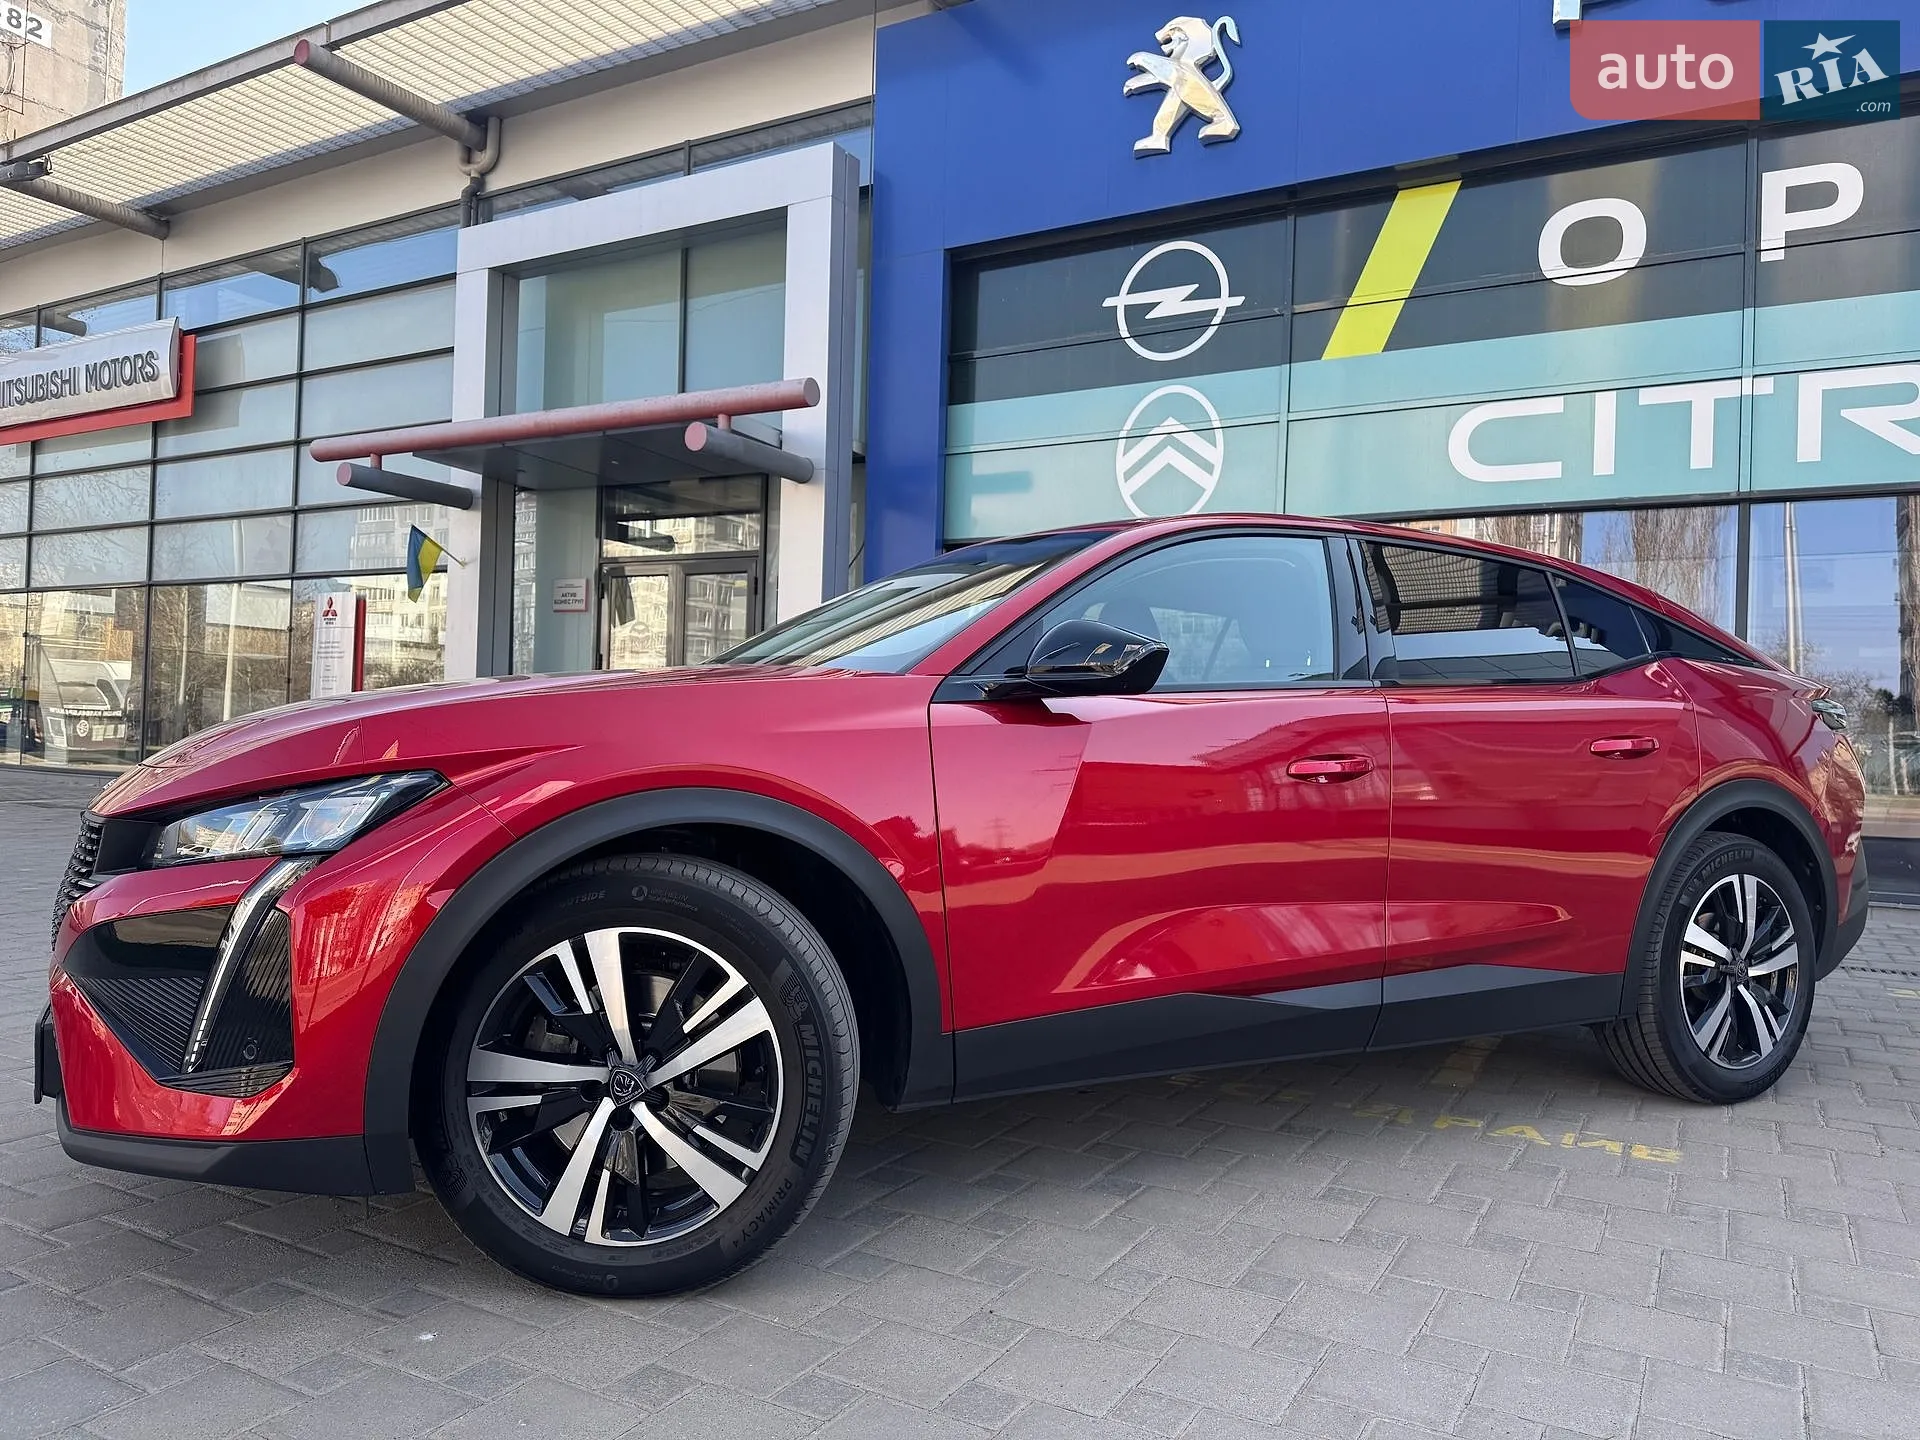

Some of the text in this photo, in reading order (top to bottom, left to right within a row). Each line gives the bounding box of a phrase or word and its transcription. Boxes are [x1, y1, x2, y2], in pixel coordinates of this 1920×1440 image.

[0, 350, 159, 409] ITSUBISHI MOTORS
[1448, 364, 1920, 483] CITR
[1701, 848, 1753, 879] MICHELIN
[798, 1022, 824, 1167] MICHELIN
[741, 1177, 794, 1244] PRIMACY
